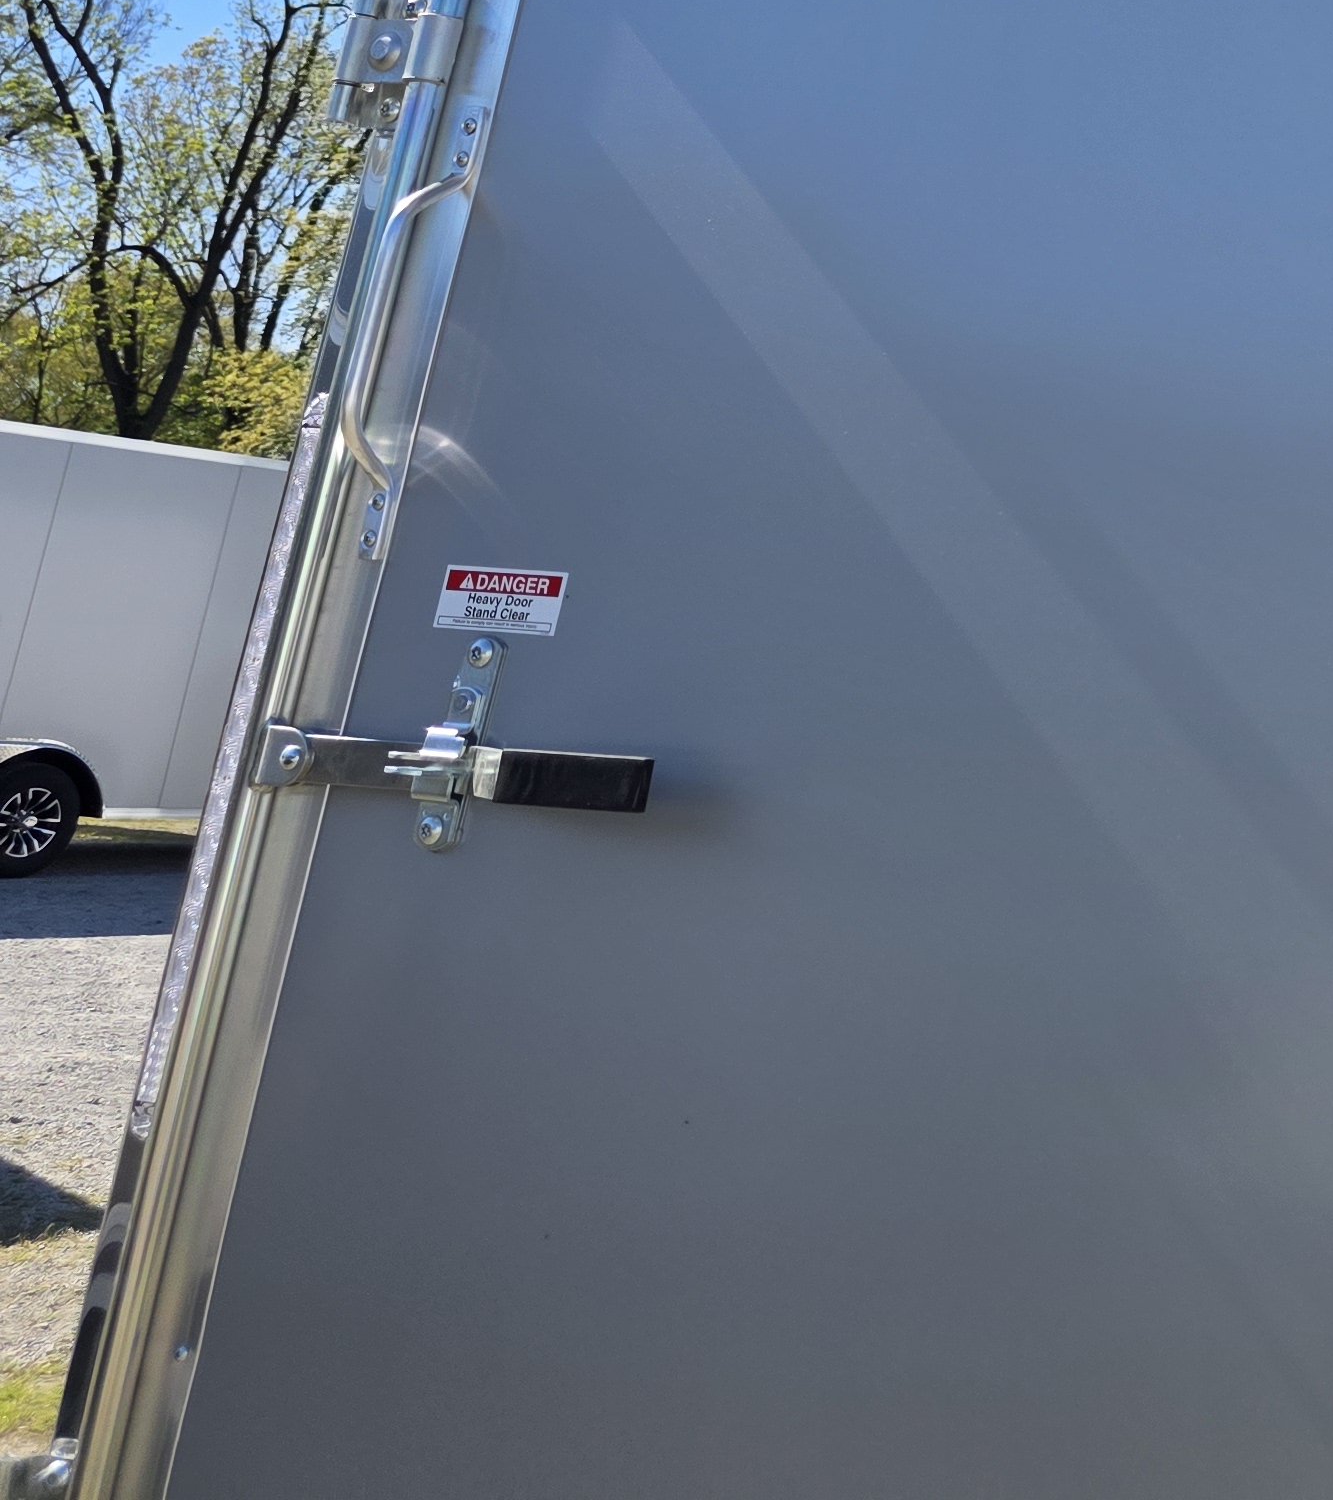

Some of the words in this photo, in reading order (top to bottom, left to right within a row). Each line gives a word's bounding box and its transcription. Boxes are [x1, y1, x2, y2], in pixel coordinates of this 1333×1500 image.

[475, 574, 550, 595] DANGER
[467, 593, 502, 609] Heavy
[505, 595, 534, 608] Door
[464, 605, 498, 619] Stand
[500, 608, 530, 621] Clear
